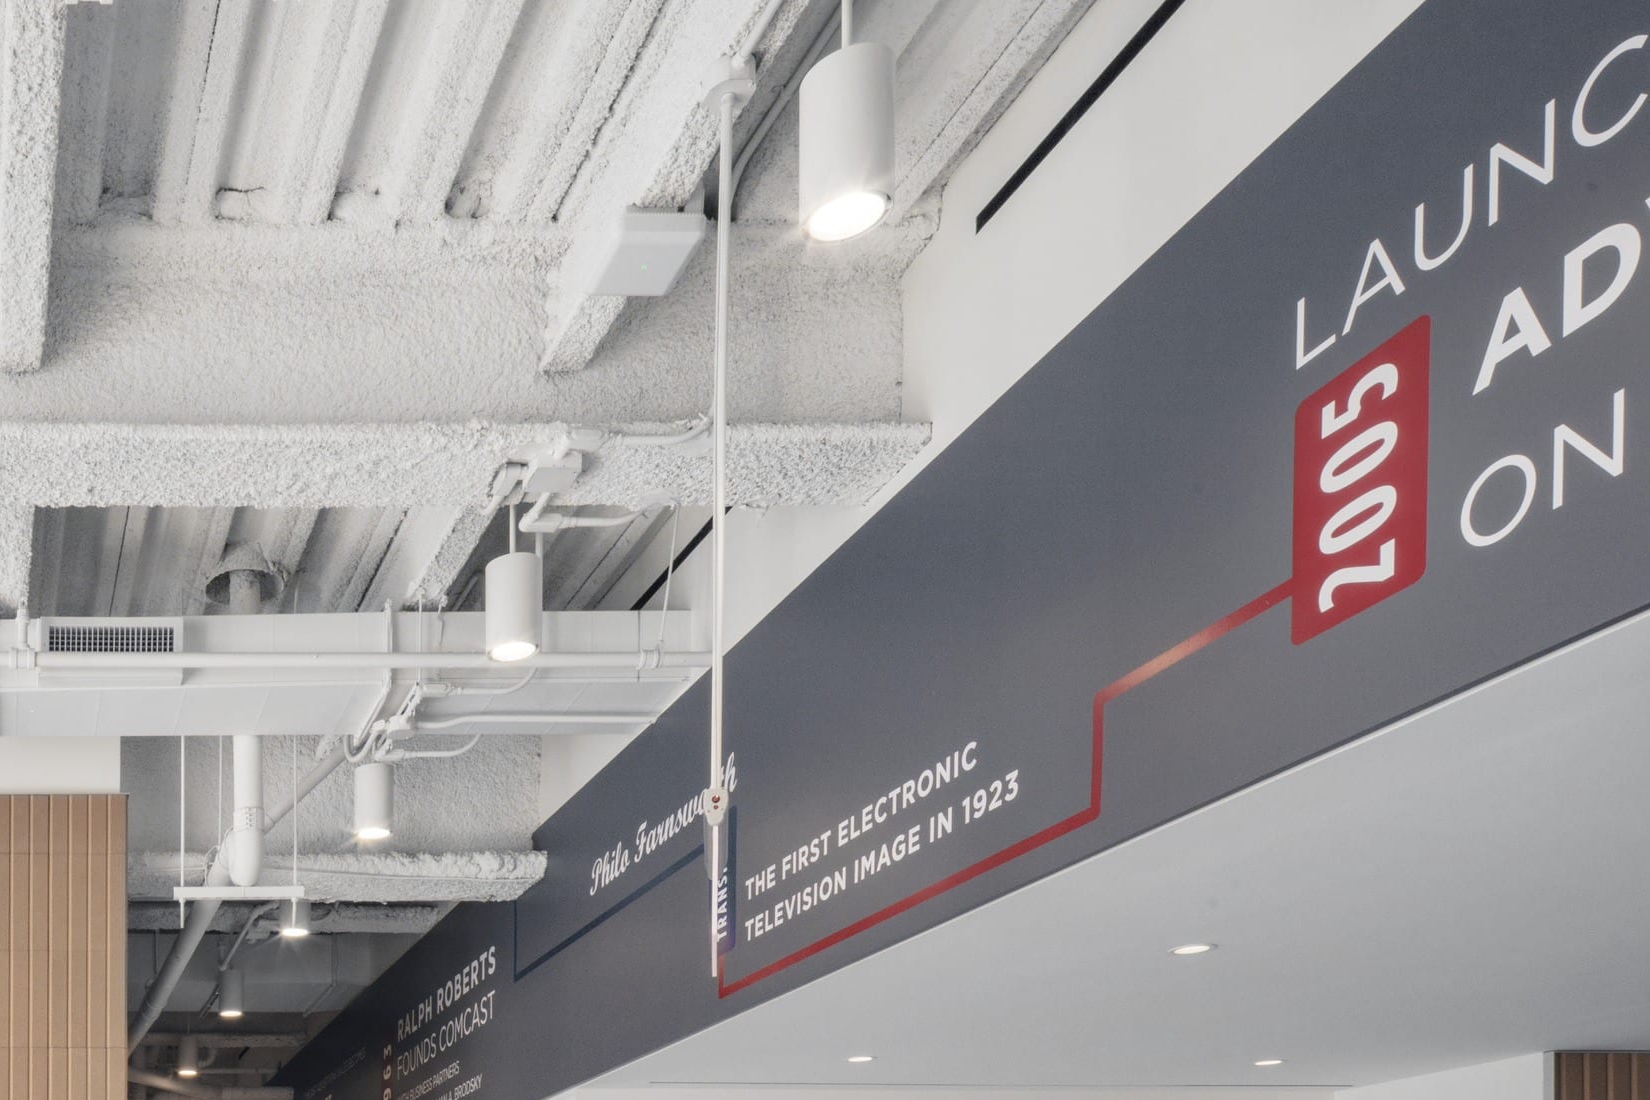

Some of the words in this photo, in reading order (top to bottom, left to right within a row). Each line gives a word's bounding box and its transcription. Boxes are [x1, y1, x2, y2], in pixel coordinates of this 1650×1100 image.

[1471, 196, 1650, 397] AD
[1318, 361, 1400, 614] 2005
[1459, 387, 1626, 548] ON
[589, 840, 631, 897] Philo
[744, 865, 847, 942] TELEVISION
[853, 823, 922, 885] IMAGE
[928, 805, 954, 844] IN
[961, 768, 1020, 825] 1923
[745, 863, 776, 901] THE
[781, 829, 832, 881] FIRST
[837, 740, 978, 848] ELECTRONIC
[397, 995, 433, 1043] RALPH
[437, 945, 496, 1015] ROBERTS
[397, 1032, 437, 1080] FOUNDS
[439, 989, 496, 1052] COMCAST
